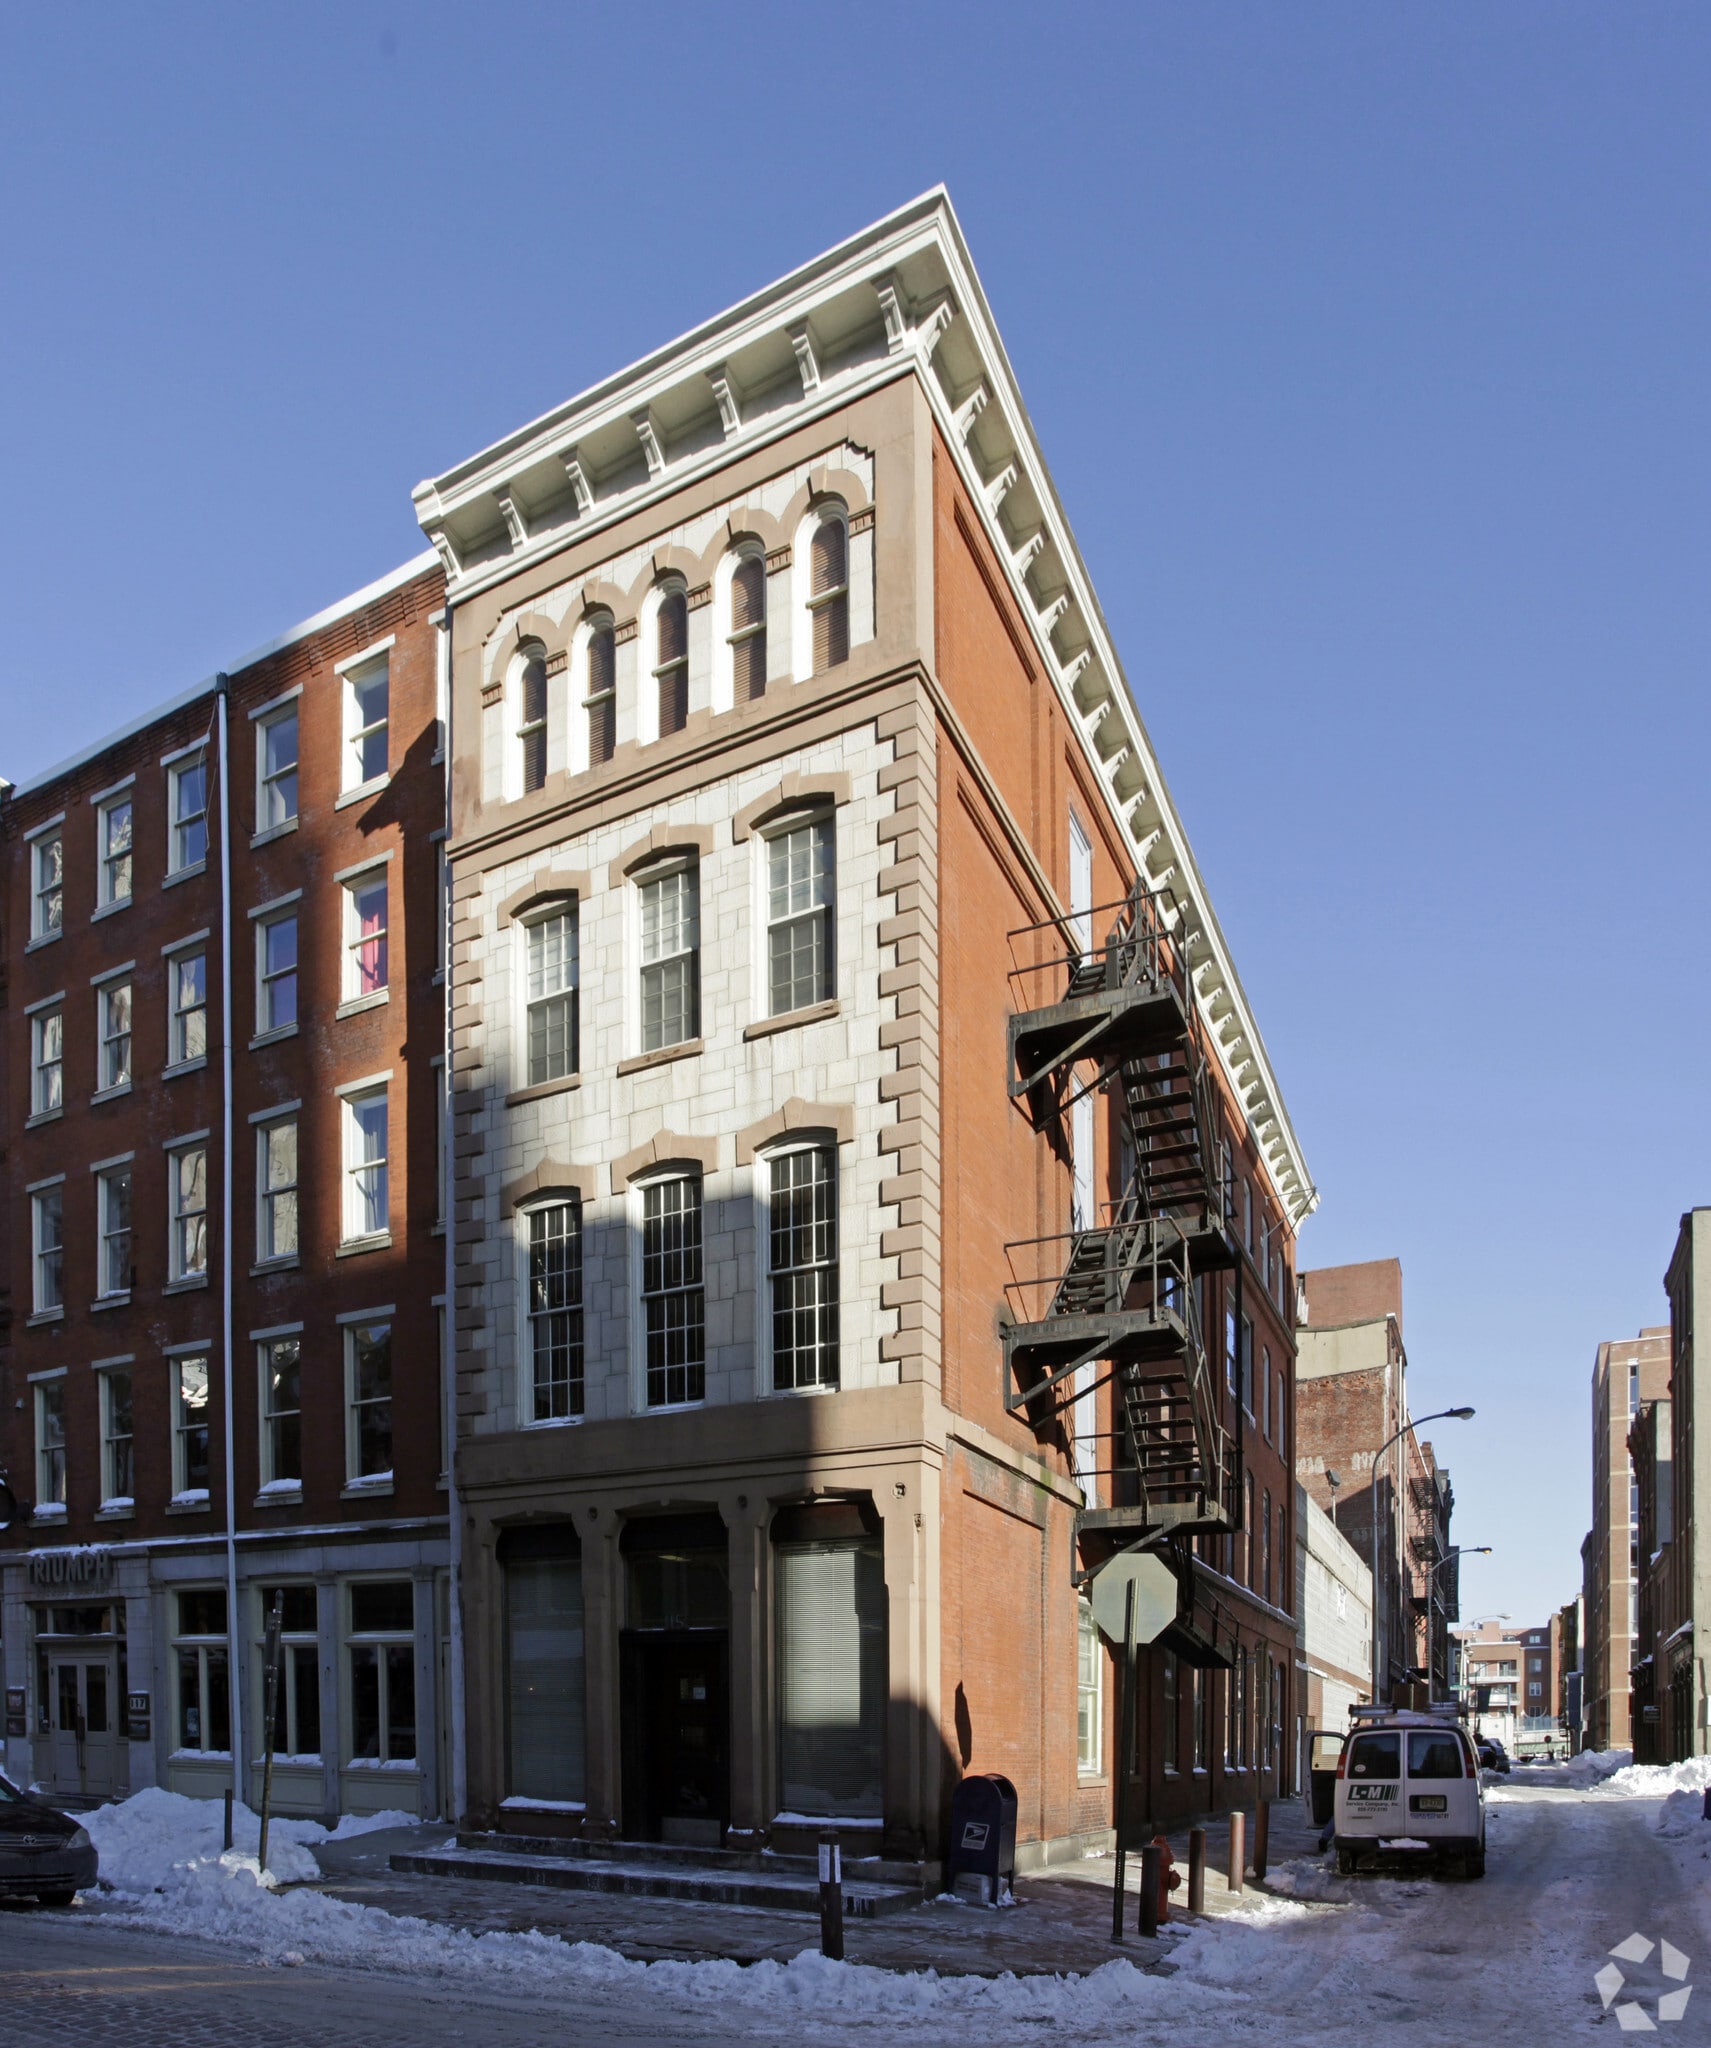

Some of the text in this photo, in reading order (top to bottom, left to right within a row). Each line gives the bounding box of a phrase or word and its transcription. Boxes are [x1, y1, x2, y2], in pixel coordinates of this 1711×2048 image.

[26, 1551, 110, 1584] TRIUMPH
[131, 1699, 144, 1708] 117
[1351, 1786, 1383, 1799] L-M
